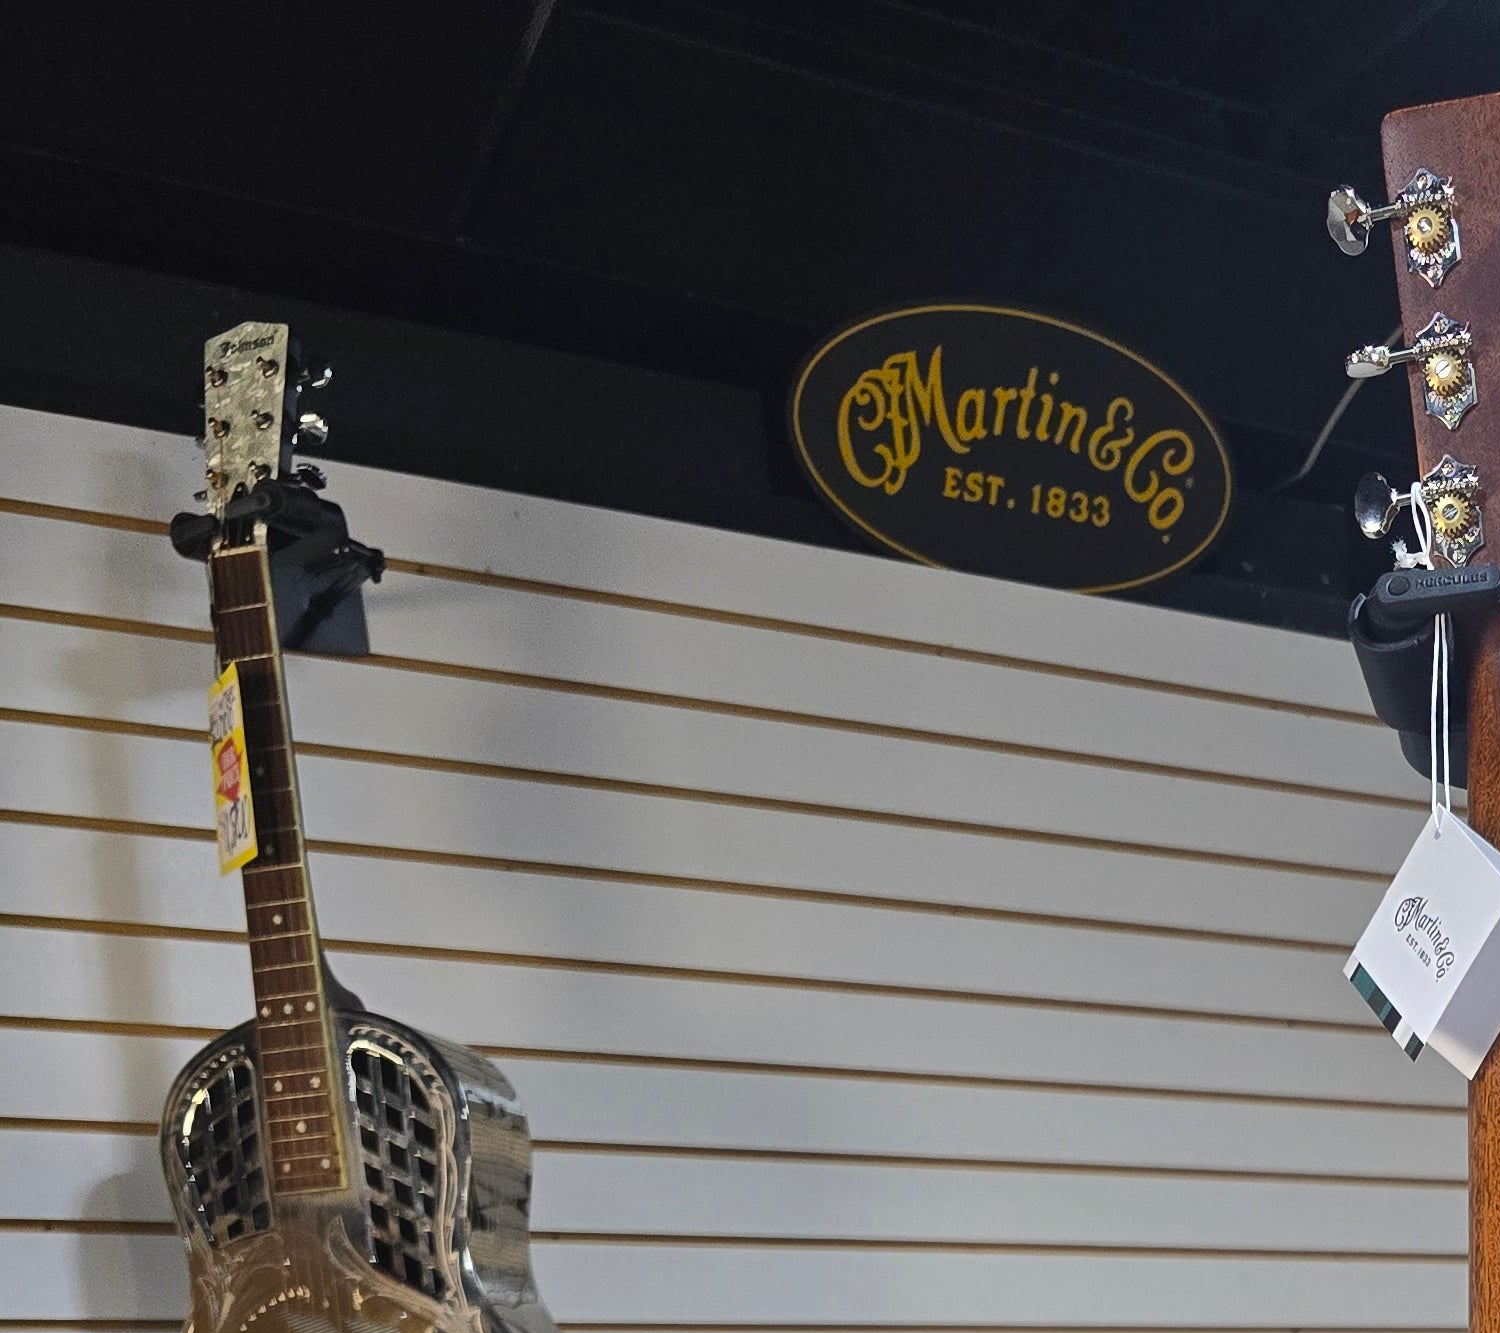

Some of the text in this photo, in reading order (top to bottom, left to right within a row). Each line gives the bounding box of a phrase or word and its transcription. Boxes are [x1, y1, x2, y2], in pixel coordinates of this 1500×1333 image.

[943, 466, 1111, 528] EST. 1833
[1417, 947, 1432, 967] 1833
